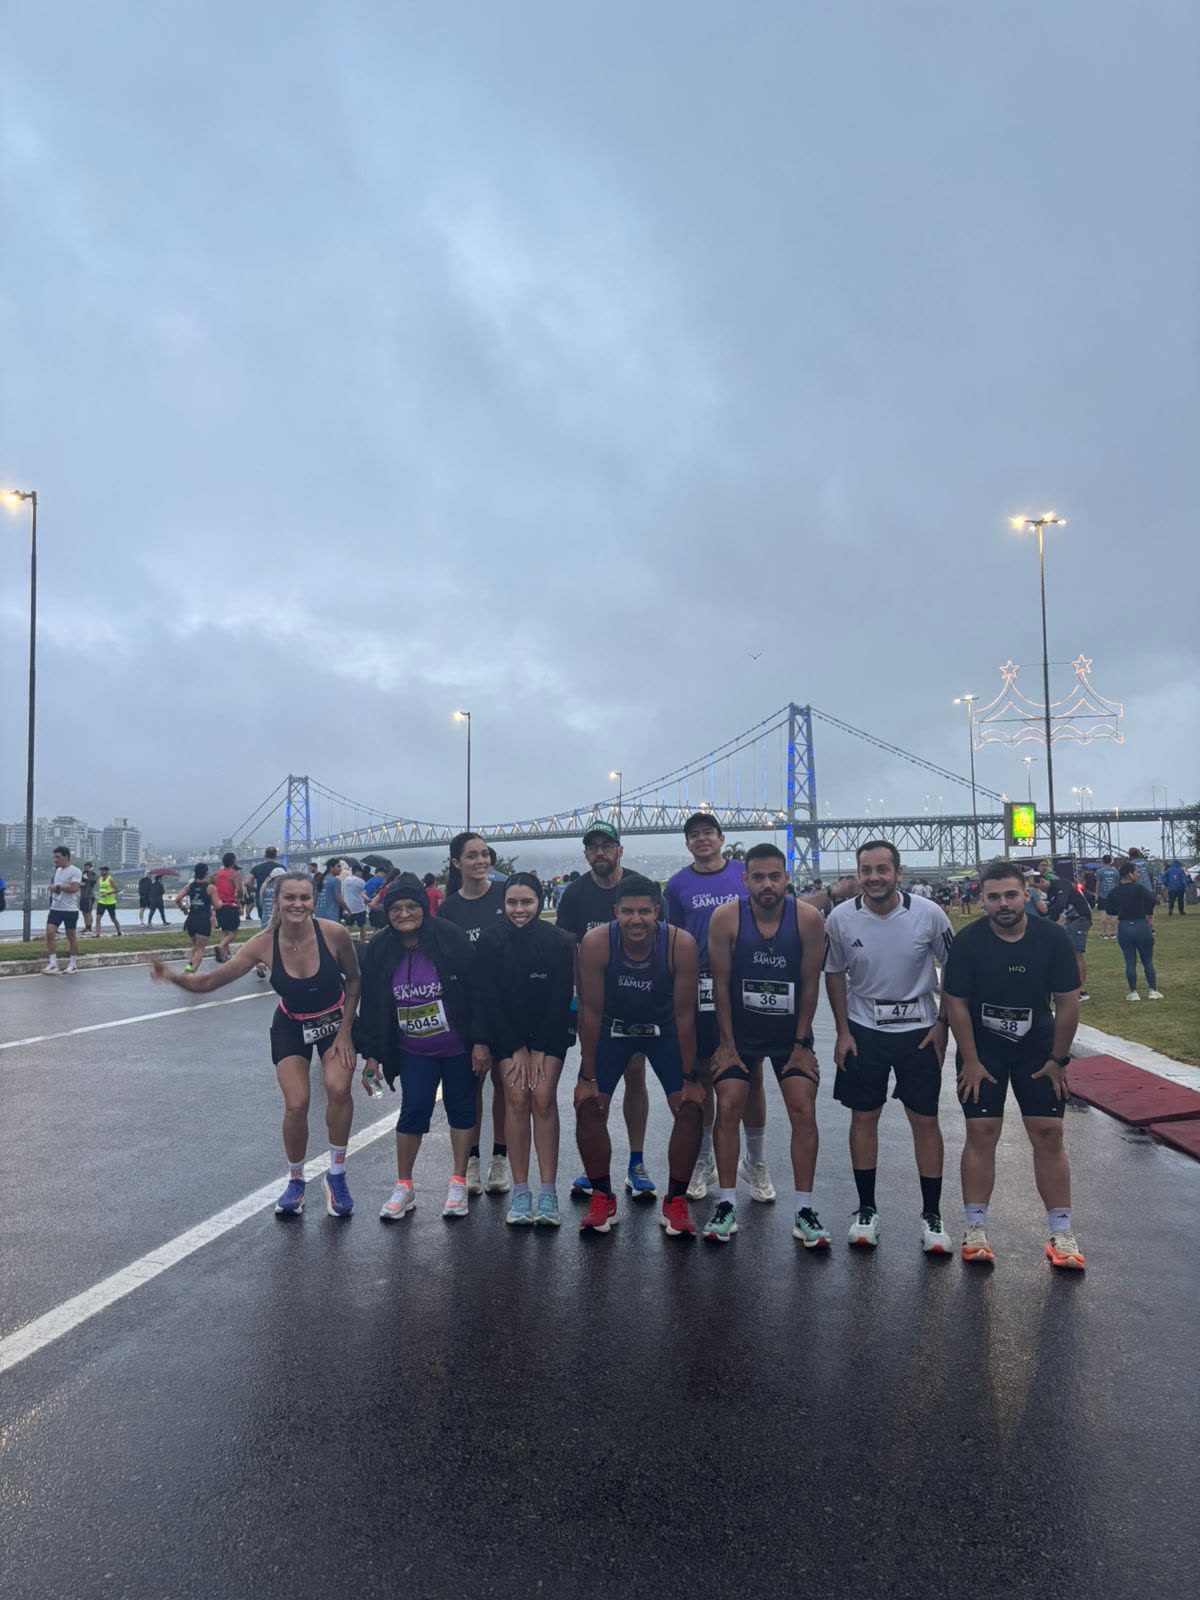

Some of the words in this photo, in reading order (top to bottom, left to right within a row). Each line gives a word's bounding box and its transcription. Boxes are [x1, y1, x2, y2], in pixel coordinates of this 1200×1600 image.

[760, 994, 777, 1006] 36
[892, 1004, 909, 1017] 47
[407, 1015, 440, 1031] 5045
[1001, 1020, 1018, 1032] 38
